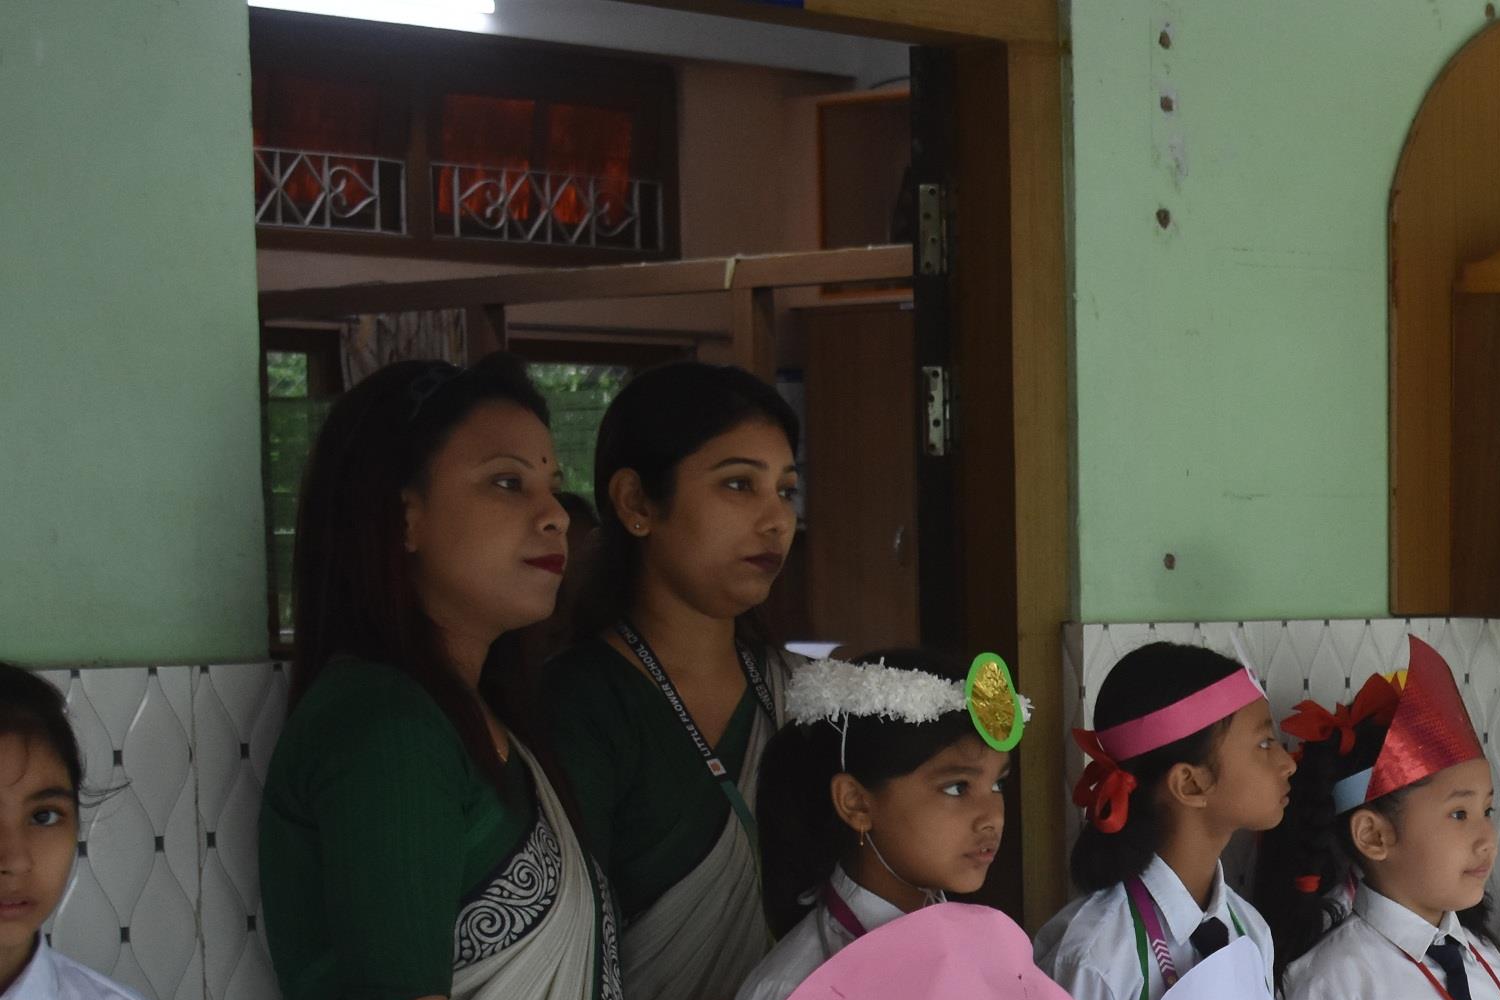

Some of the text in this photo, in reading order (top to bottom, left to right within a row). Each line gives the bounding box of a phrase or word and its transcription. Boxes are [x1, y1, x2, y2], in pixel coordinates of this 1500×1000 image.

[636, 643, 666, 682] SCHOOL
[661, 682, 690, 723] FLOWER
[685, 722, 711, 757] LITTLE
